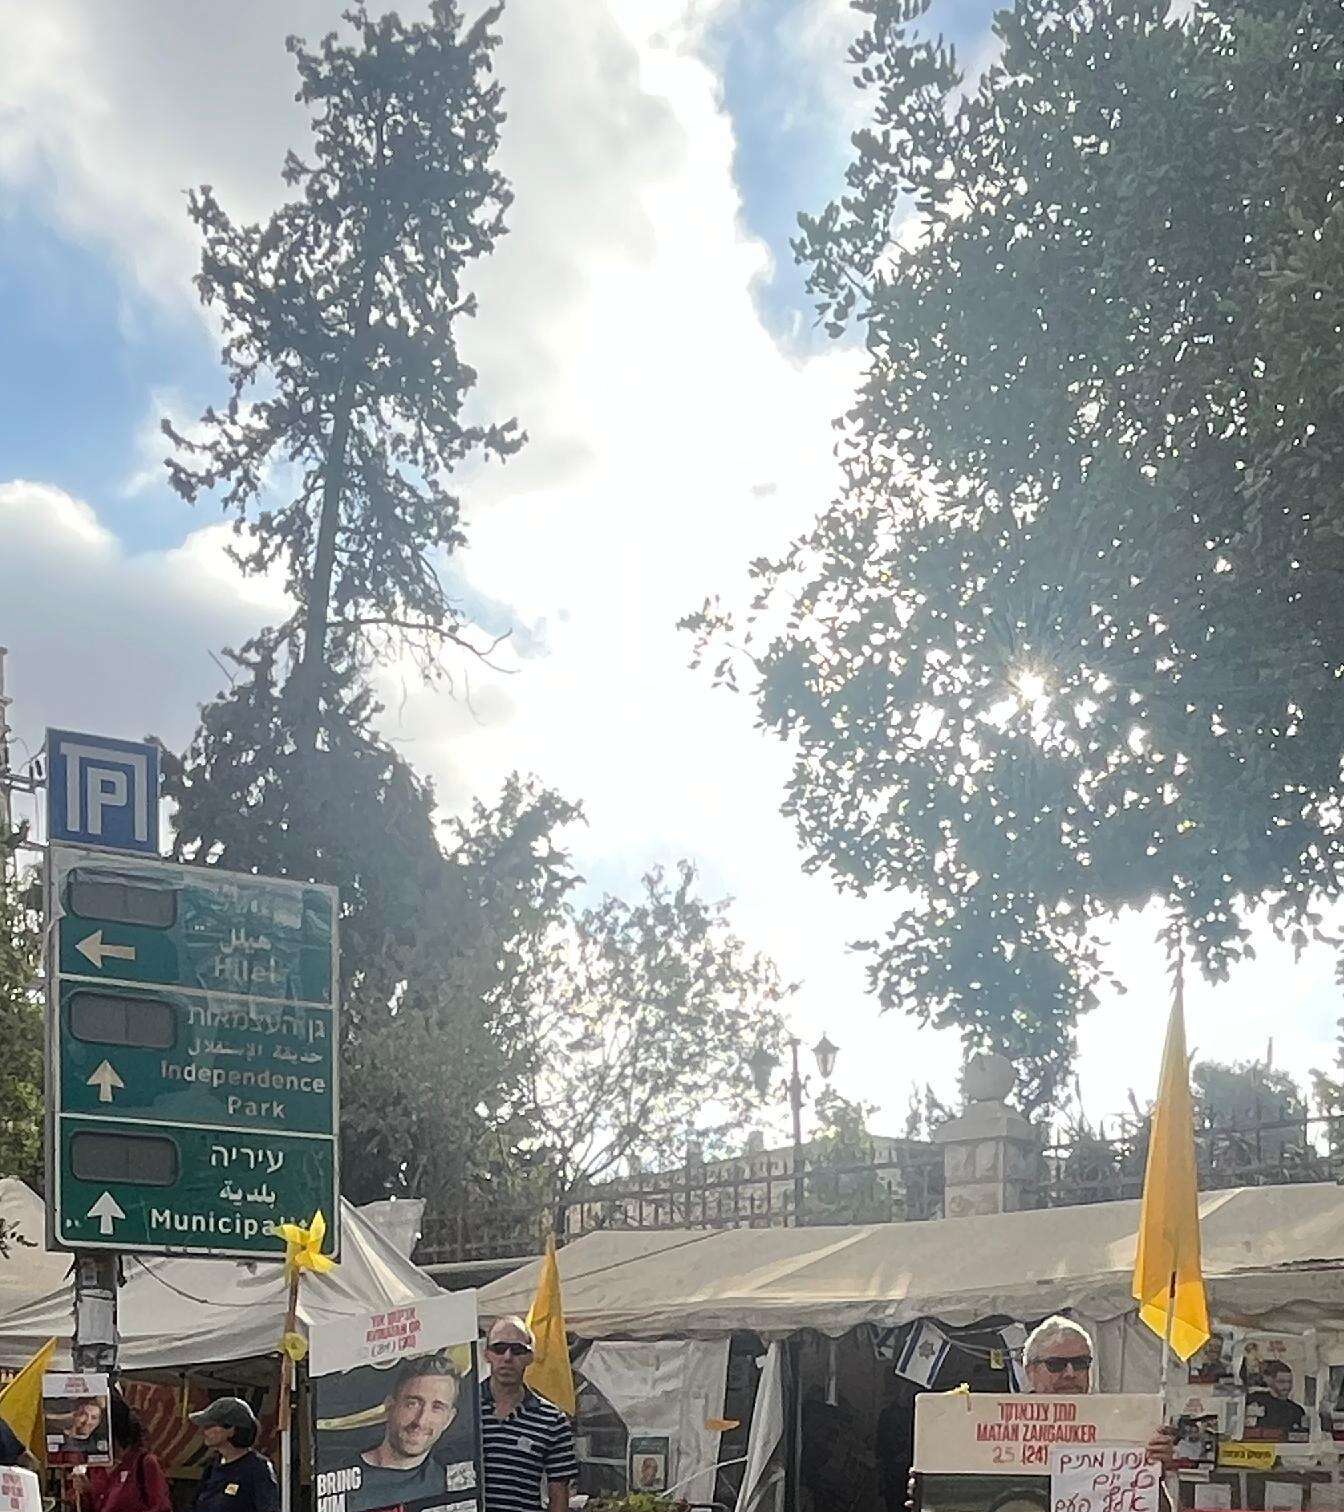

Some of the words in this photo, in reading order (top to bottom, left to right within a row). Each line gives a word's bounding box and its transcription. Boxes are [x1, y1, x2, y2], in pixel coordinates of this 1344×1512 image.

[161, 1060, 326, 1093] Independence
[228, 1096, 287, 1119] Park
[210, 1145, 285, 1173] עיריה
[220, 1180, 276, 1209] بلدية
[151, 1208, 308, 1239] Municipa
[977, 1424, 1019, 1442] MATAN
[1022, 1424, 1097, 1443] ZANGAUKER
[317, 1466, 362, 1496] BRING
